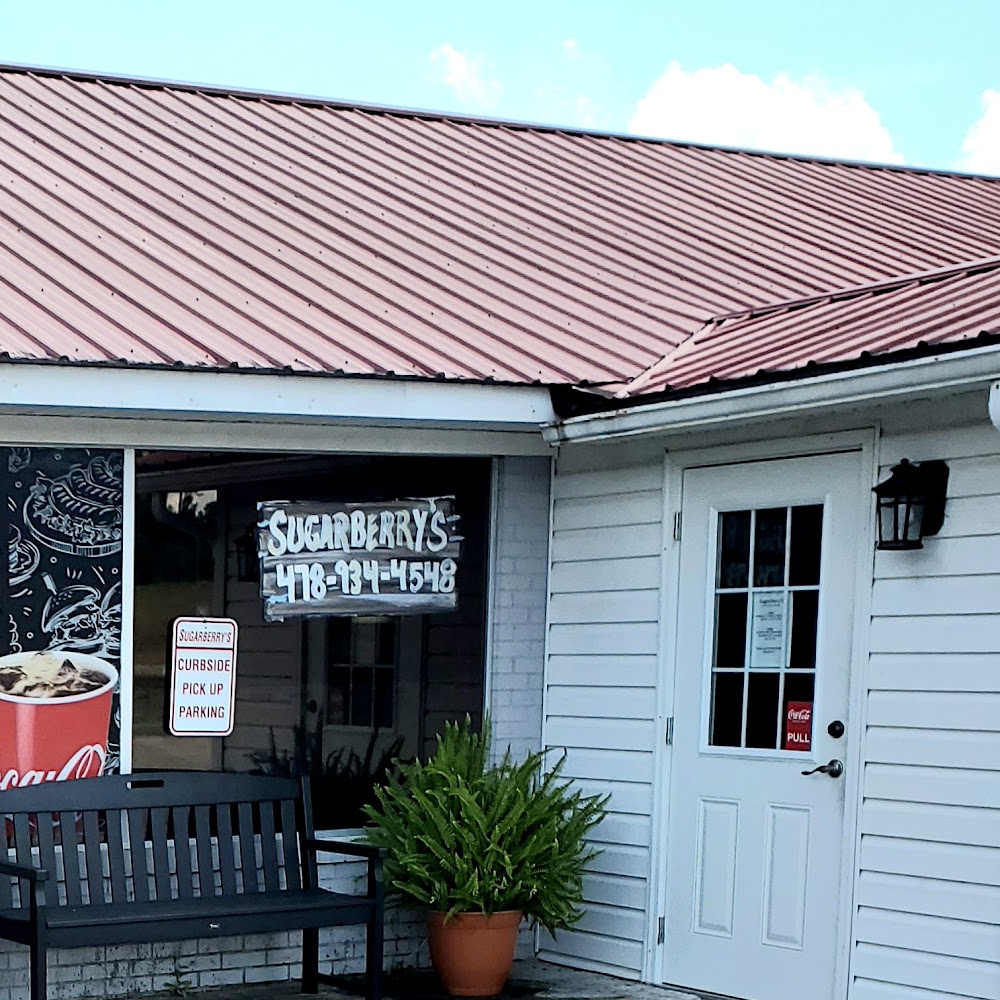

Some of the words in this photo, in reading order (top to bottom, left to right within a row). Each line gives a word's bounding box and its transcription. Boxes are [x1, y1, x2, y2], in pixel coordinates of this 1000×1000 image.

[267, 500, 448, 556] SUGARBERRY'S
[275, 558, 458, 603] 478-934-4548
[179, 629, 232, 643] SUGARBERRY'S
[178, 659, 231, 672] CURBSIDE
[182, 682, 206, 695] PICK
[209, 683, 224, 695] UP
[179, 706, 225, 719] PARKING
[787, 732, 811, 743] PULL
